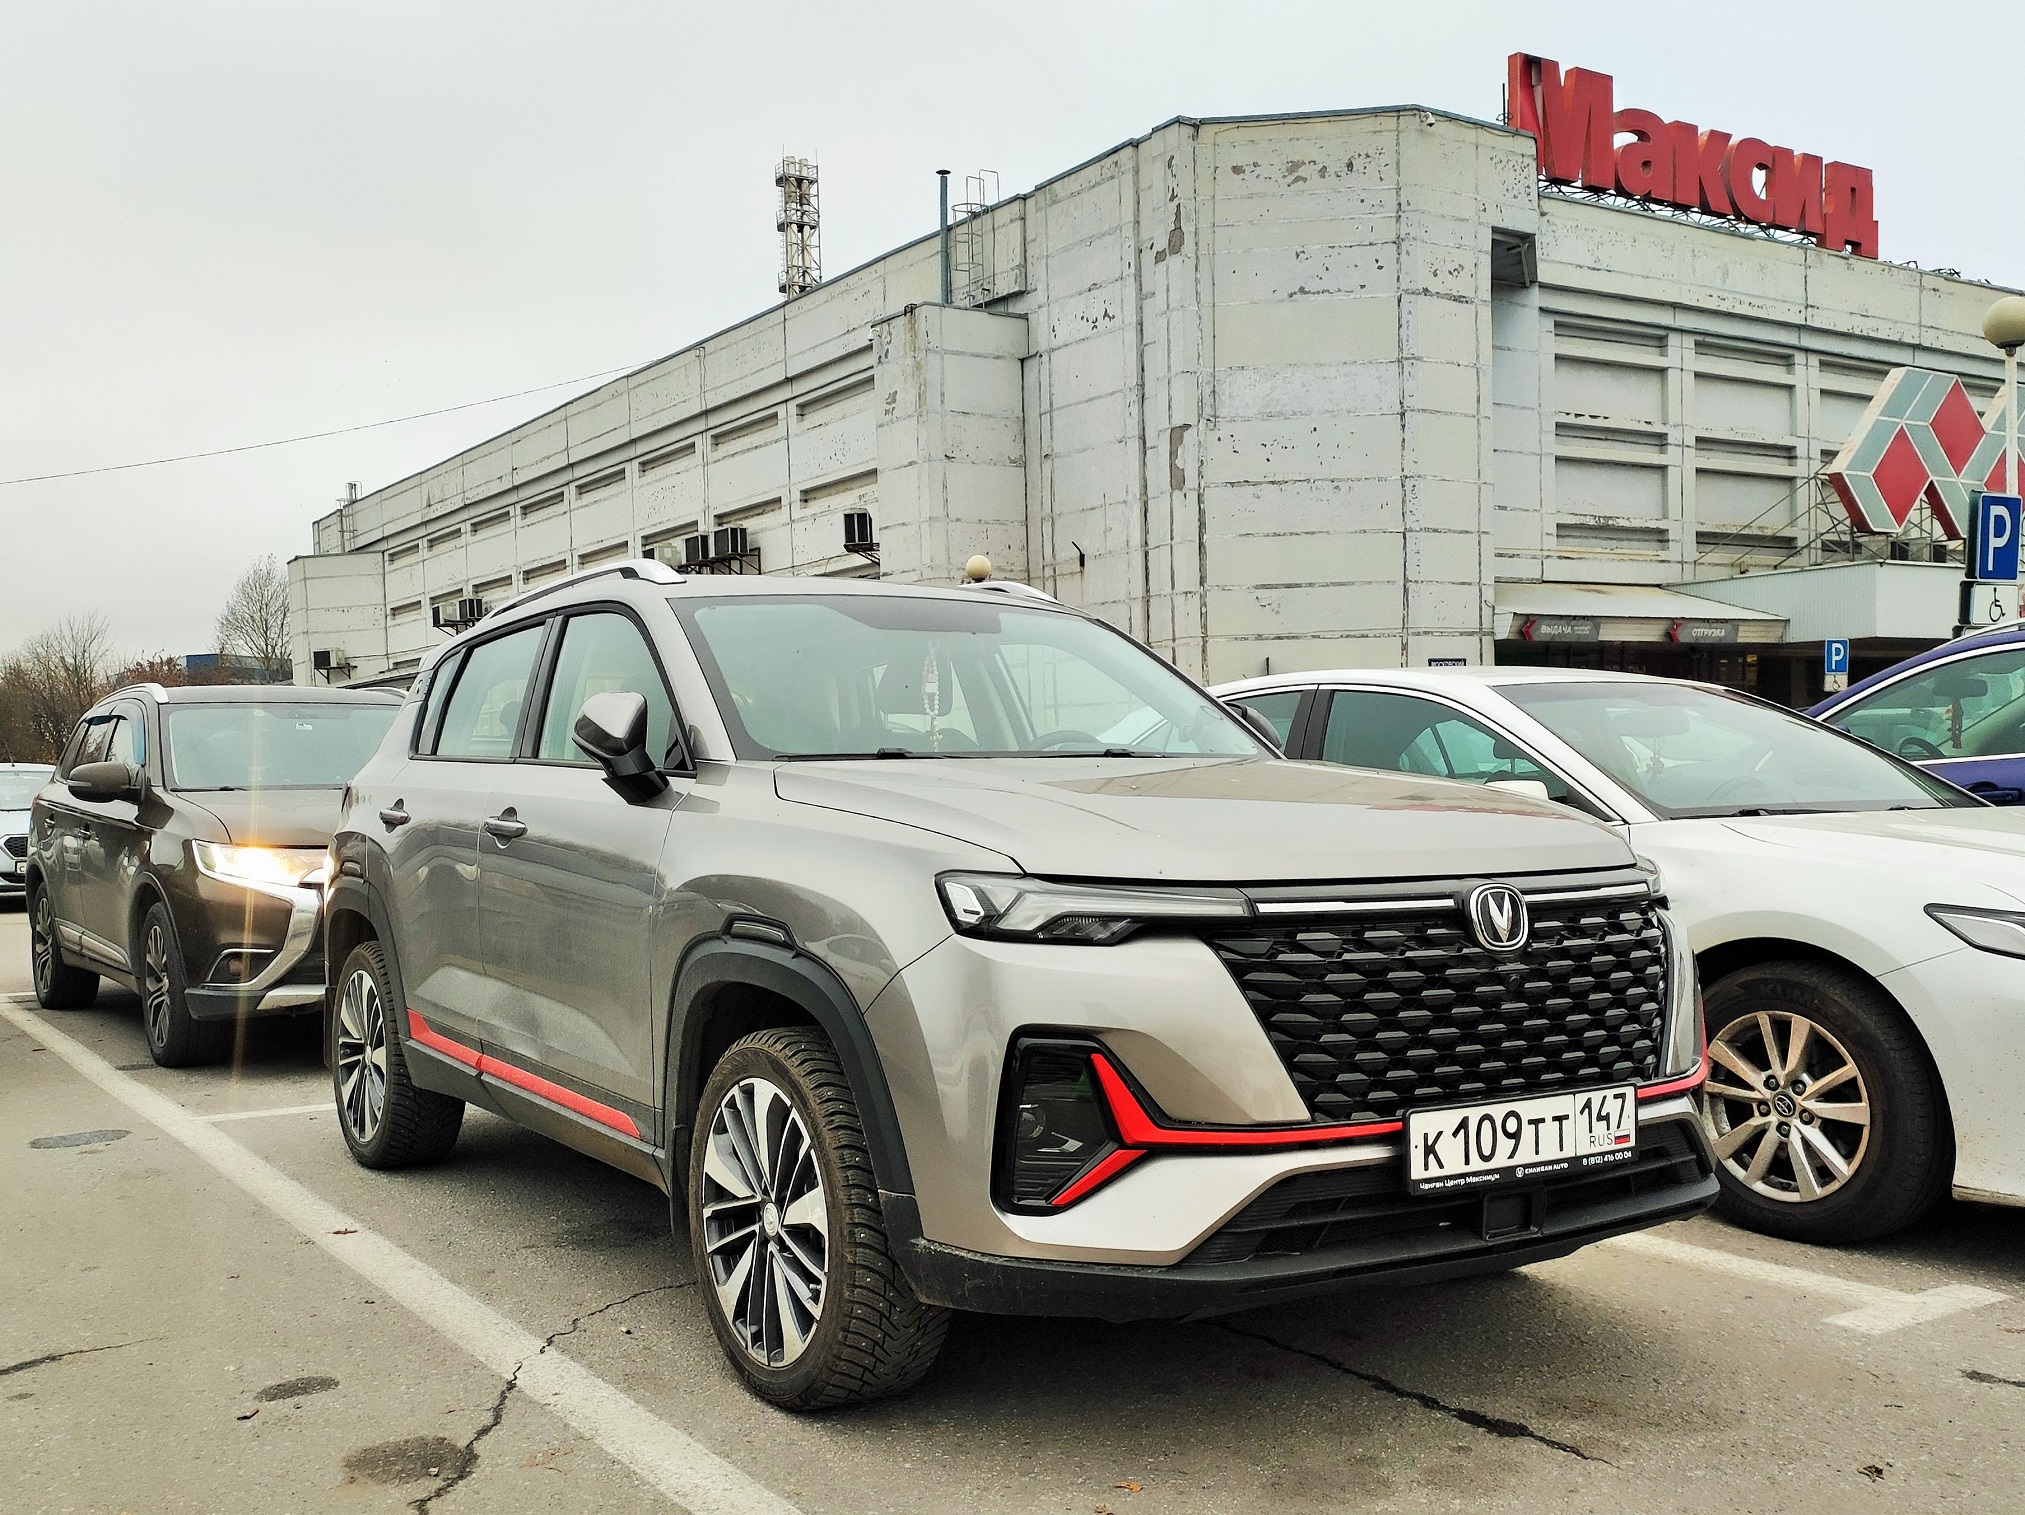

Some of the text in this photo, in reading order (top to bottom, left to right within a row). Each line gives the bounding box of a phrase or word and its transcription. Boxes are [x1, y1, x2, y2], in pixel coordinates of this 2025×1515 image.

[1987, 505, 2011, 571] P
[1541, 625, 1571, 635] ВЫДАЧА
[1692, 628, 1725, 637] ОТГРУЗКА
[1831, 643, 1844, 670] P
[1579, 1092, 1627, 1134] 147
[1589, 1133, 1613, 1148] RUS
[1588, 1155, 1603, 1166] (812)
[1615, 1152, 1623, 1160] 00
[1623, 1150, 1632, 1158] 04
[1525, 1162, 1569, 1174] CHANGAN AUTO
[1420, 1173, 1500, 1190] Чанган Центр Максимум
